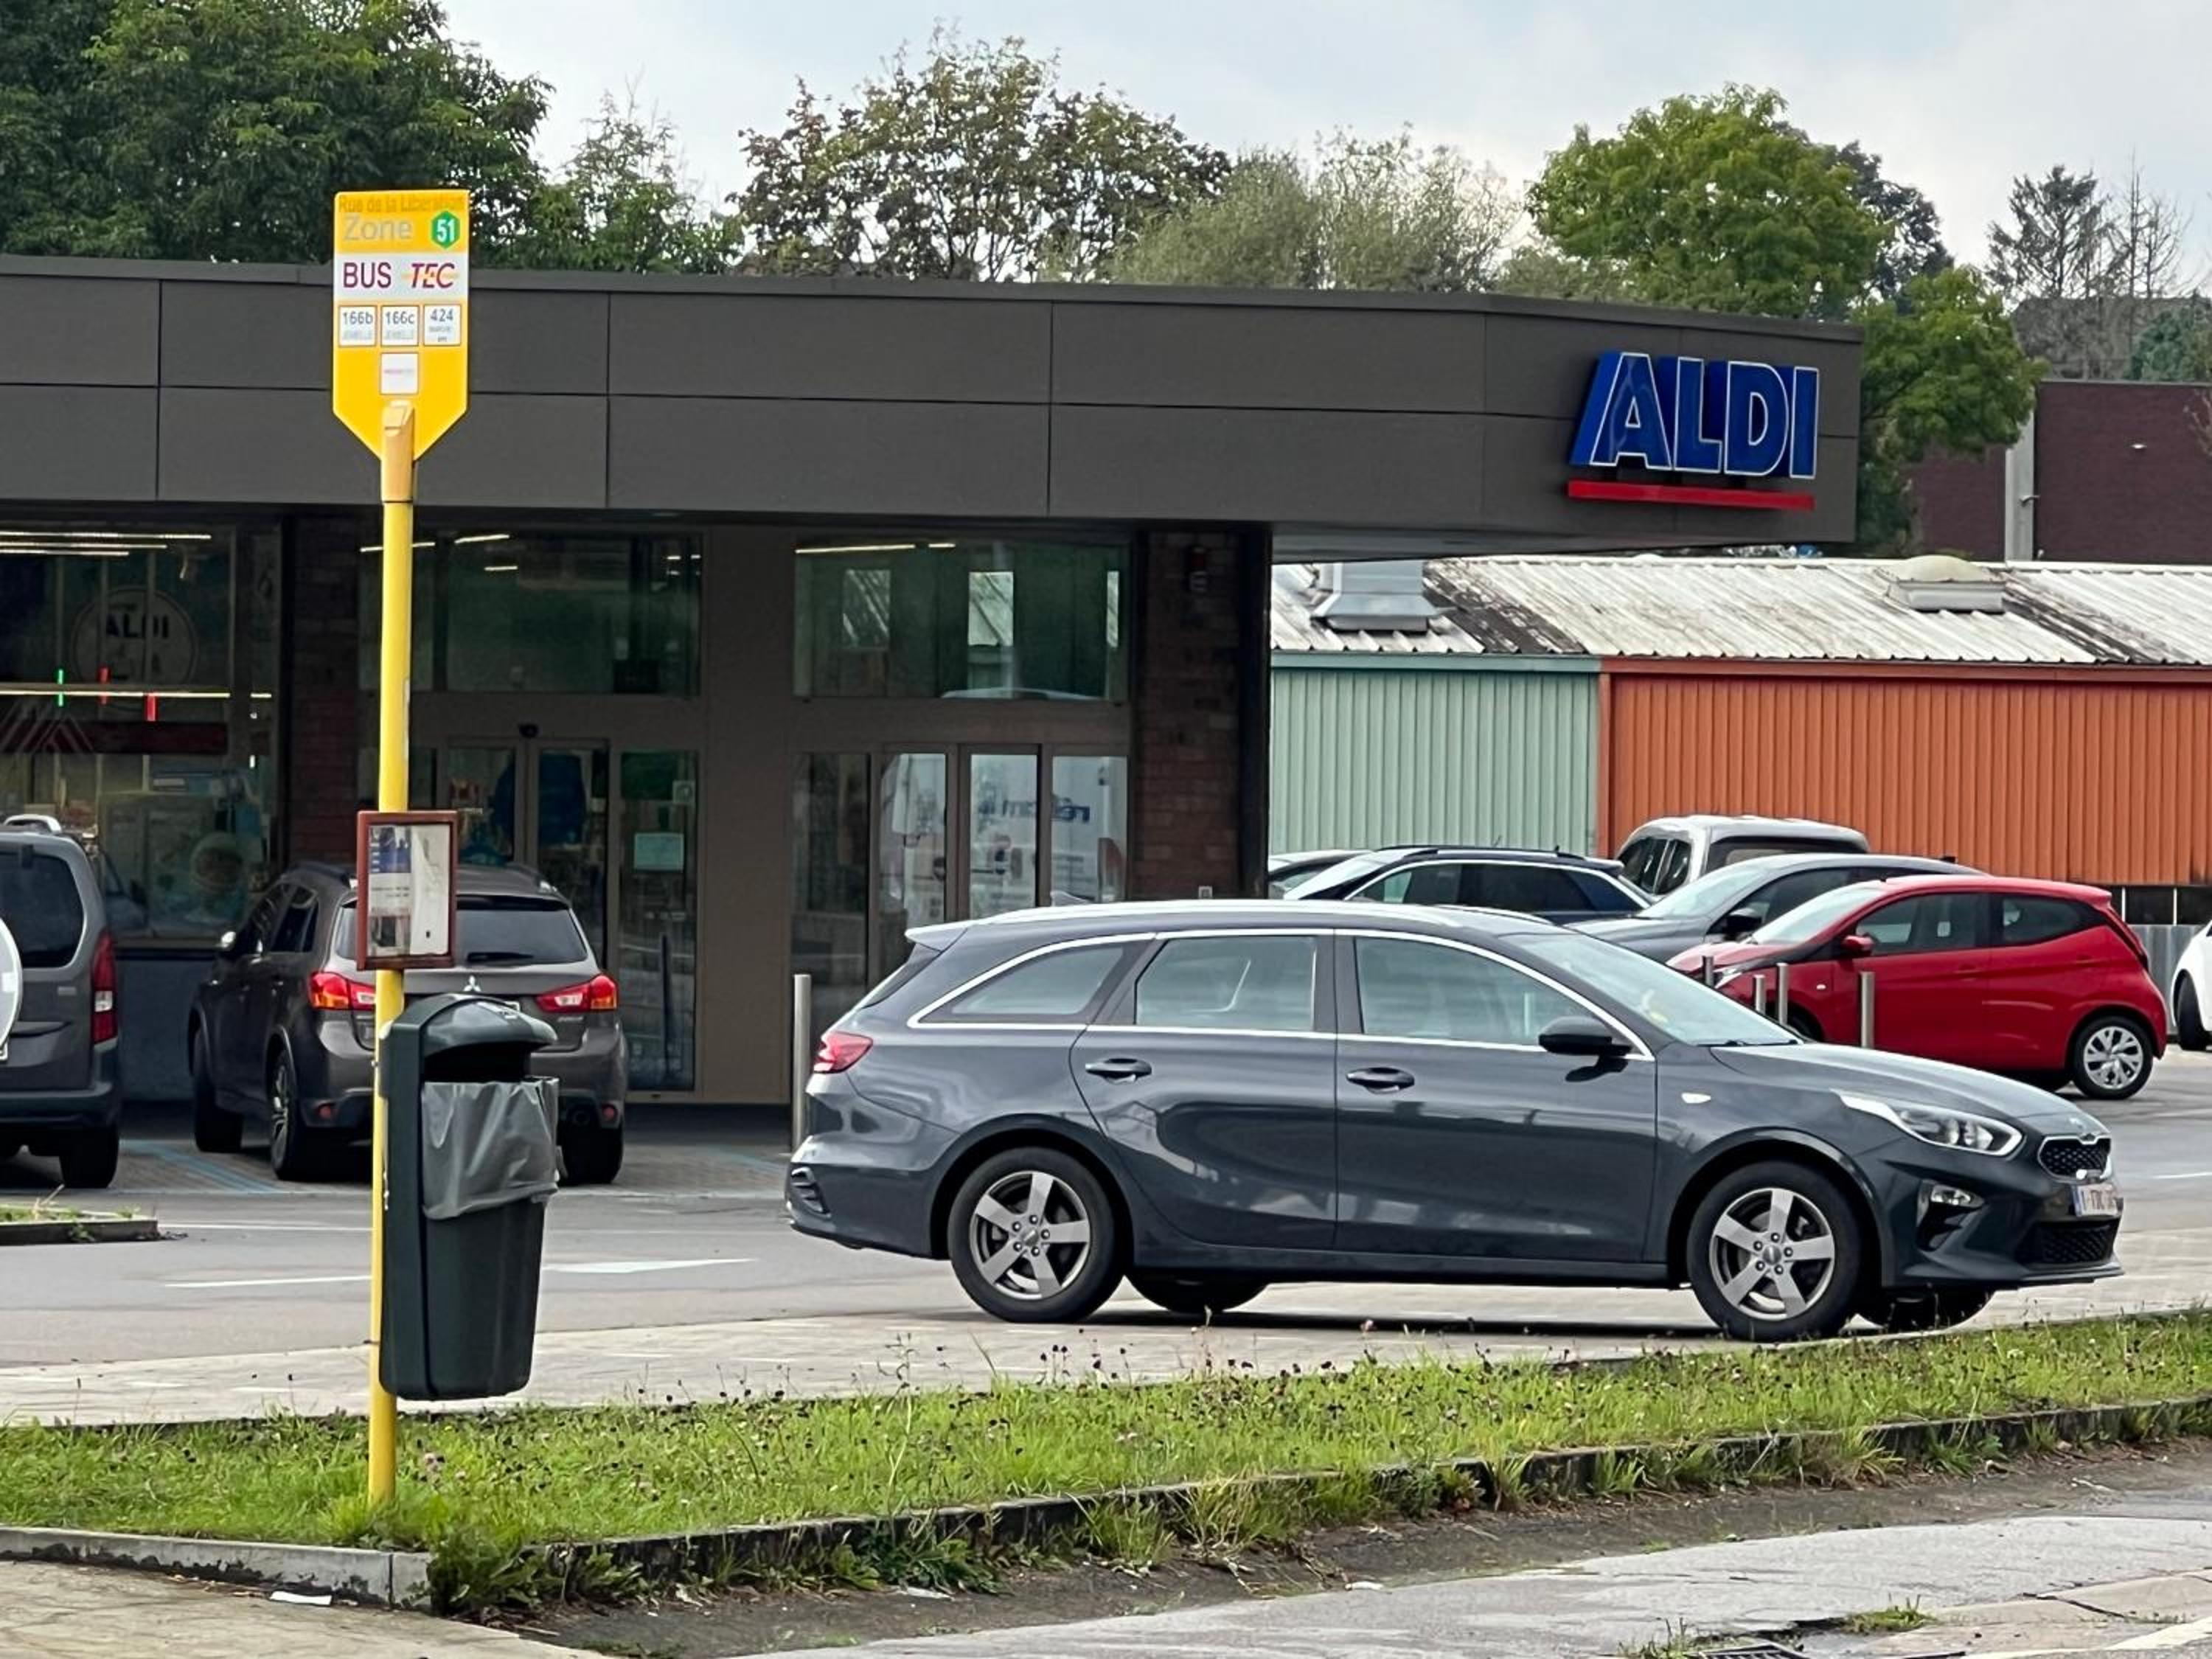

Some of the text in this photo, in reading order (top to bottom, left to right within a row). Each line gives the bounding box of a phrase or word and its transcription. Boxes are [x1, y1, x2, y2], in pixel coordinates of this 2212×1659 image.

[344, 214, 456, 243] Zone 51
[343, 262, 456, 288] BUS TEC
[343, 311, 373, 324] 166b
[386, 311, 415, 324] 166c
[430, 308, 453, 321] 424
[1571, 351, 1819, 479] ALDI
